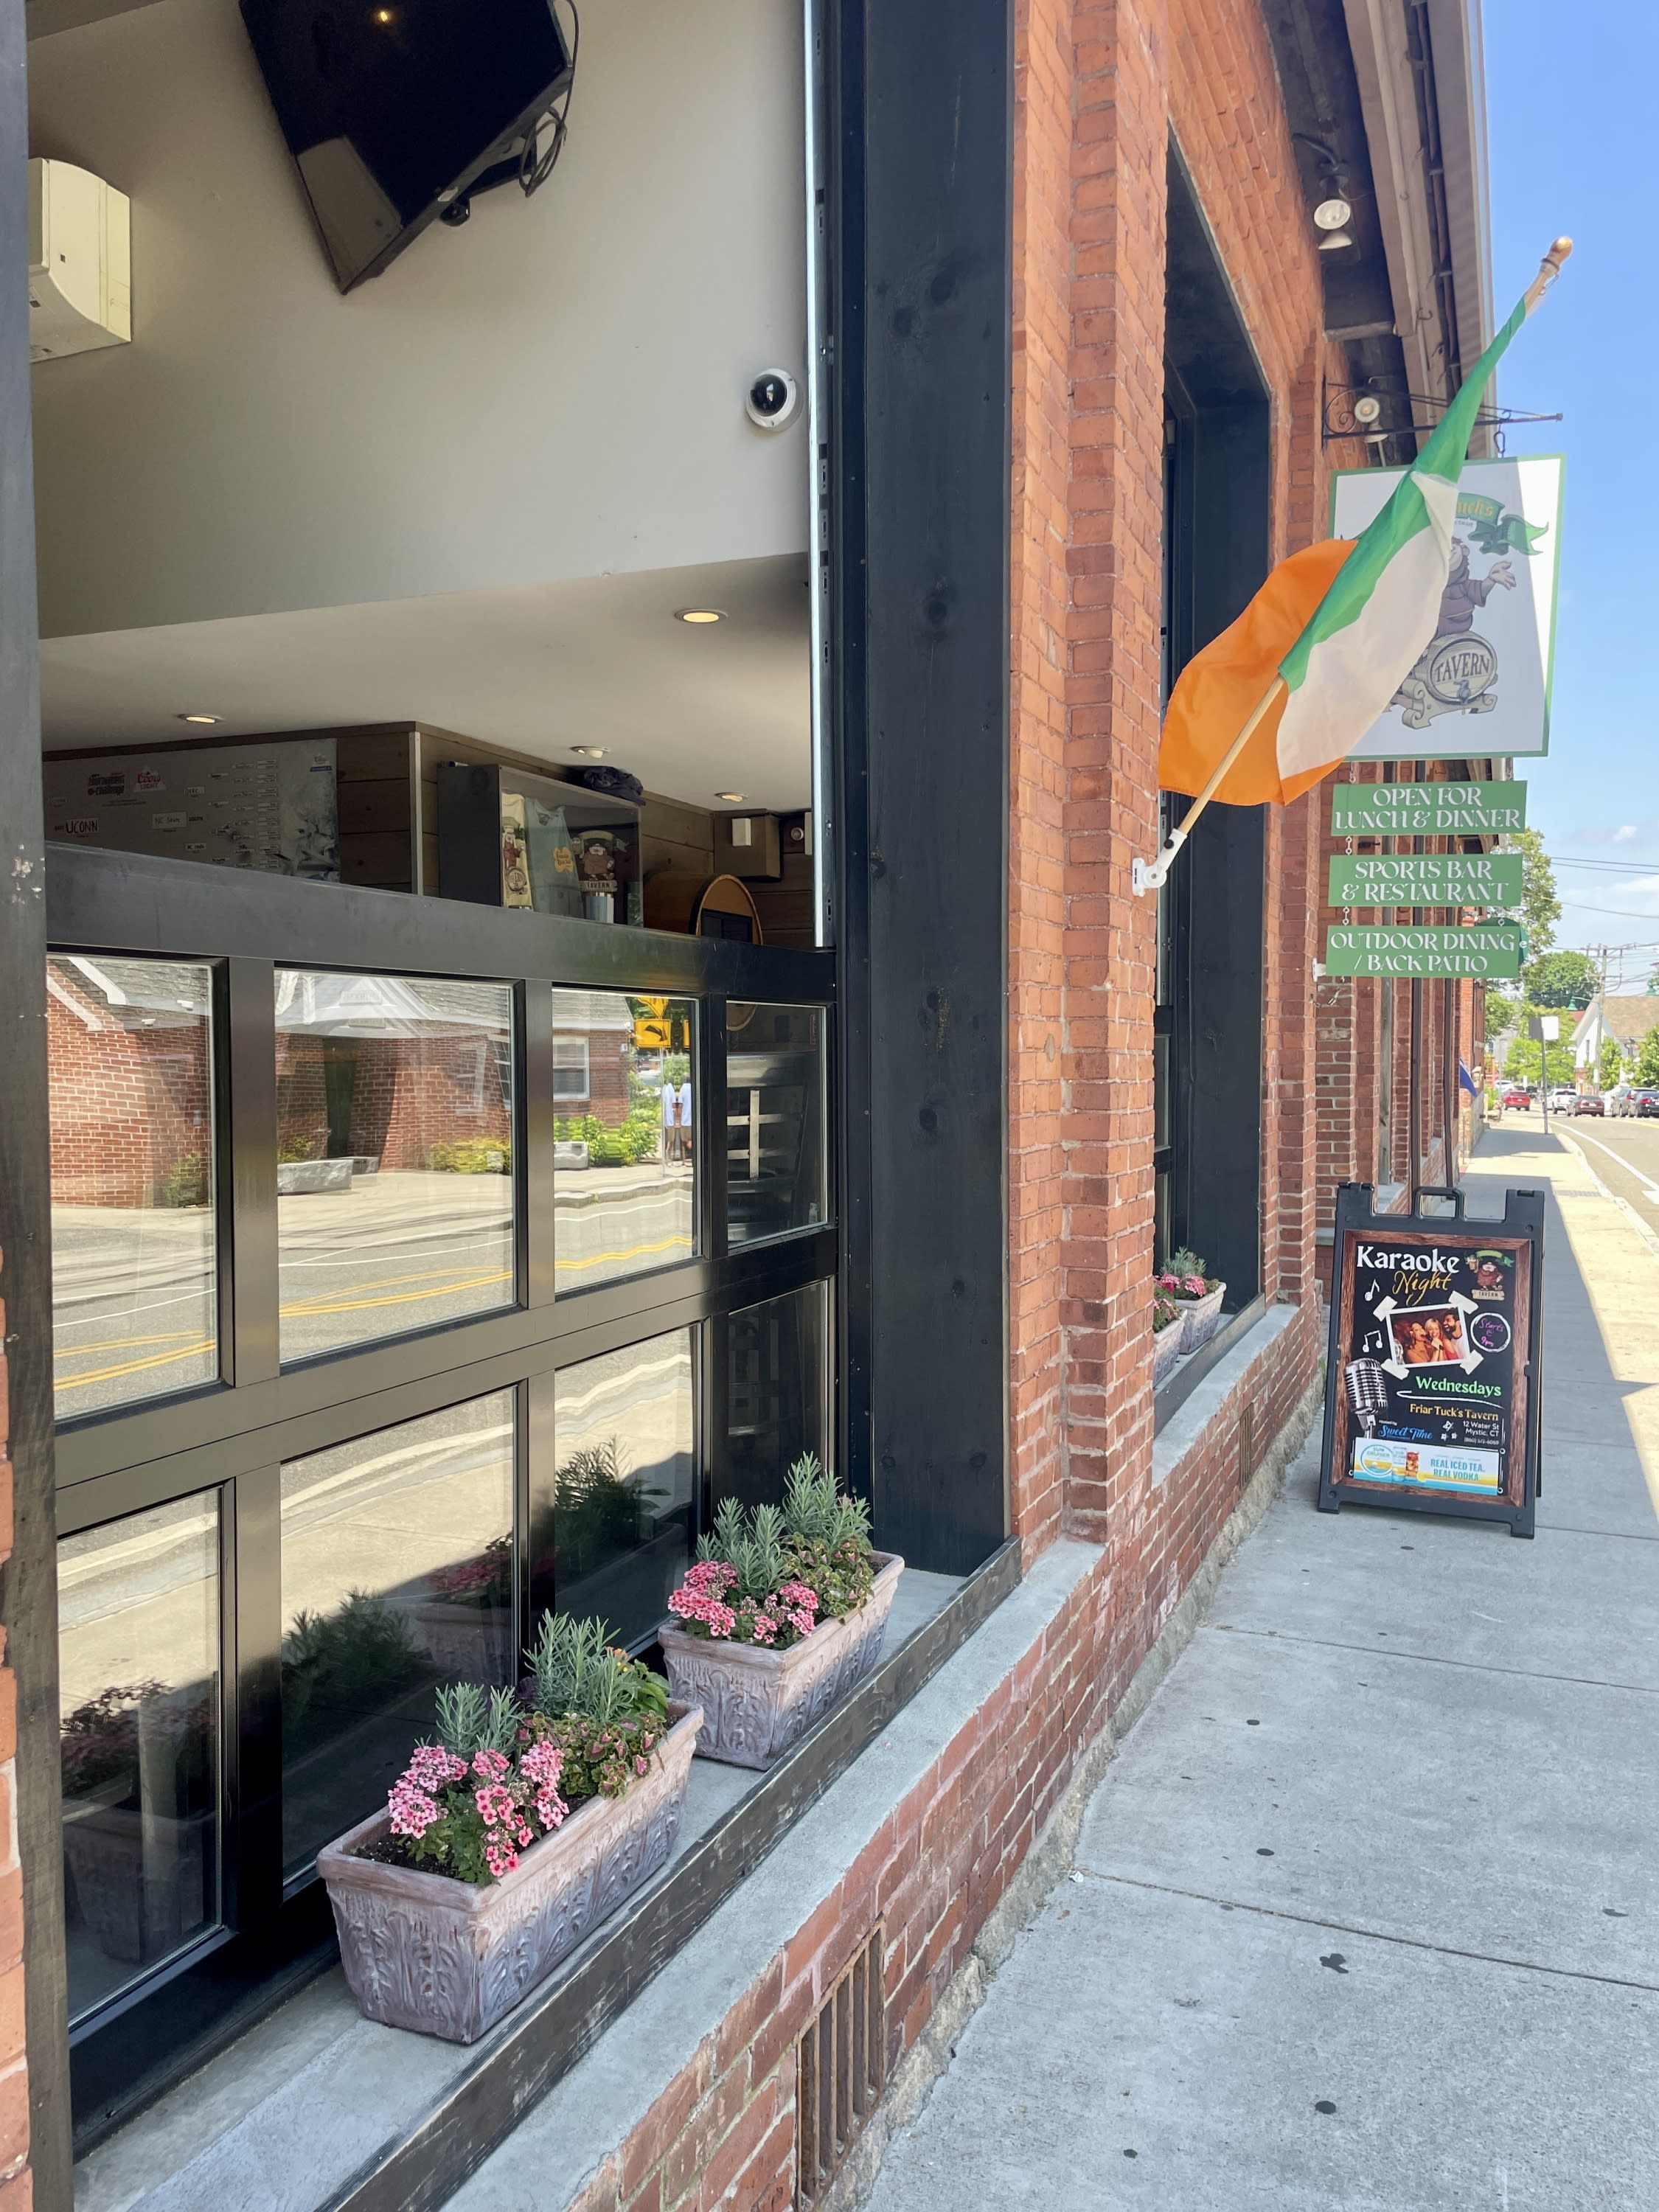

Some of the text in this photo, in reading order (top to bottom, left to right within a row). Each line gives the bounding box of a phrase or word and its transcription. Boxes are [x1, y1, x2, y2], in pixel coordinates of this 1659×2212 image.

[1434, 653, 1490, 683] TAVERN
[1373, 787, 1483, 807] OPEN FOR
[65, 819, 97, 834] UCONN
[1335, 809, 1521, 830] LUNCH & DINNER
[1355, 860, 1493, 880] SPORTS BAR
[1342, 883, 1509, 902] & RESTAURANT
[1330, 932, 1439, 951] OUTDOOR
[1443, 933, 1515, 951] DINING
[1368, 954, 1422, 971] BACK
[1427, 955, 1488, 972] PATIO
[1357, 1245, 1460, 1274] Karaoke
[1392, 1270, 1452, 1306] Night
[1416, 1375, 1502, 1398] Wednesdays
[1410, 1403, 1499, 1421] Friar Tuck's Tavern
[1377, 1425, 1408, 1437] Sweet
[1409, 1427, 1433, 1440] Time
[1471, 1421, 1490, 1429] Water
[1430, 1458, 1448, 1469] REAL
[1450, 1460, 1468, 1470] ICED
[1433, 1469, 1451, 1478] REAL
